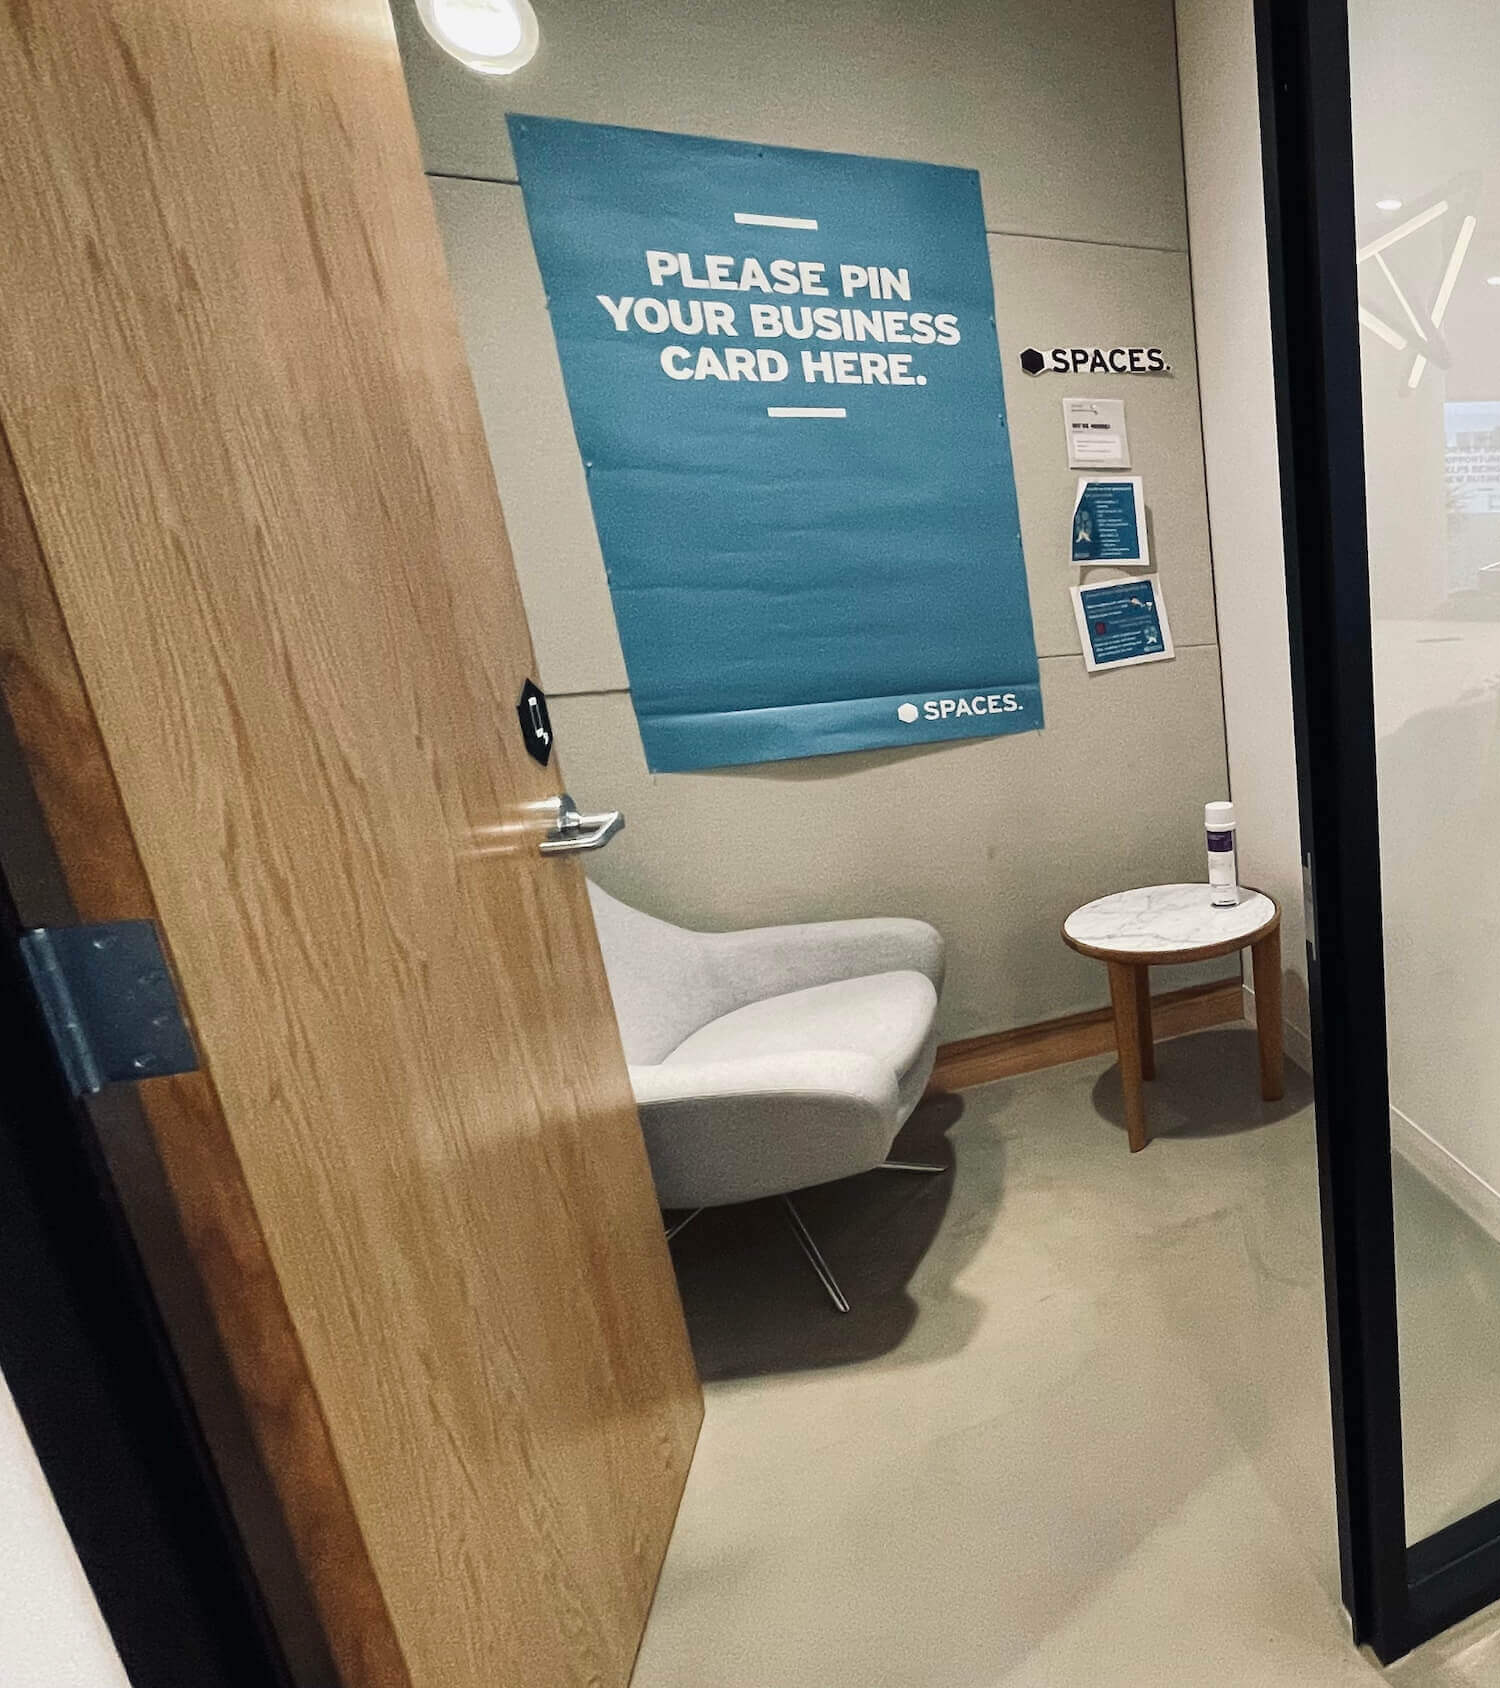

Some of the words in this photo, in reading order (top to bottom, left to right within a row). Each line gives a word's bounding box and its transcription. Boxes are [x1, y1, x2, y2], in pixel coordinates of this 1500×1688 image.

[646, 250, 829, 296] PLEASE
[840, 264, 911, 301] PIN
[596, 295, 738, 336] YOUR
[750, 304, 960, 345] BUSINESS
[660, 346, 789, 382] CARD
[801, 350, 927, 386] HERE.
[1052, 348, 1171, 374] SPACES.
[923, 693, 1024, 721] SPACES.
